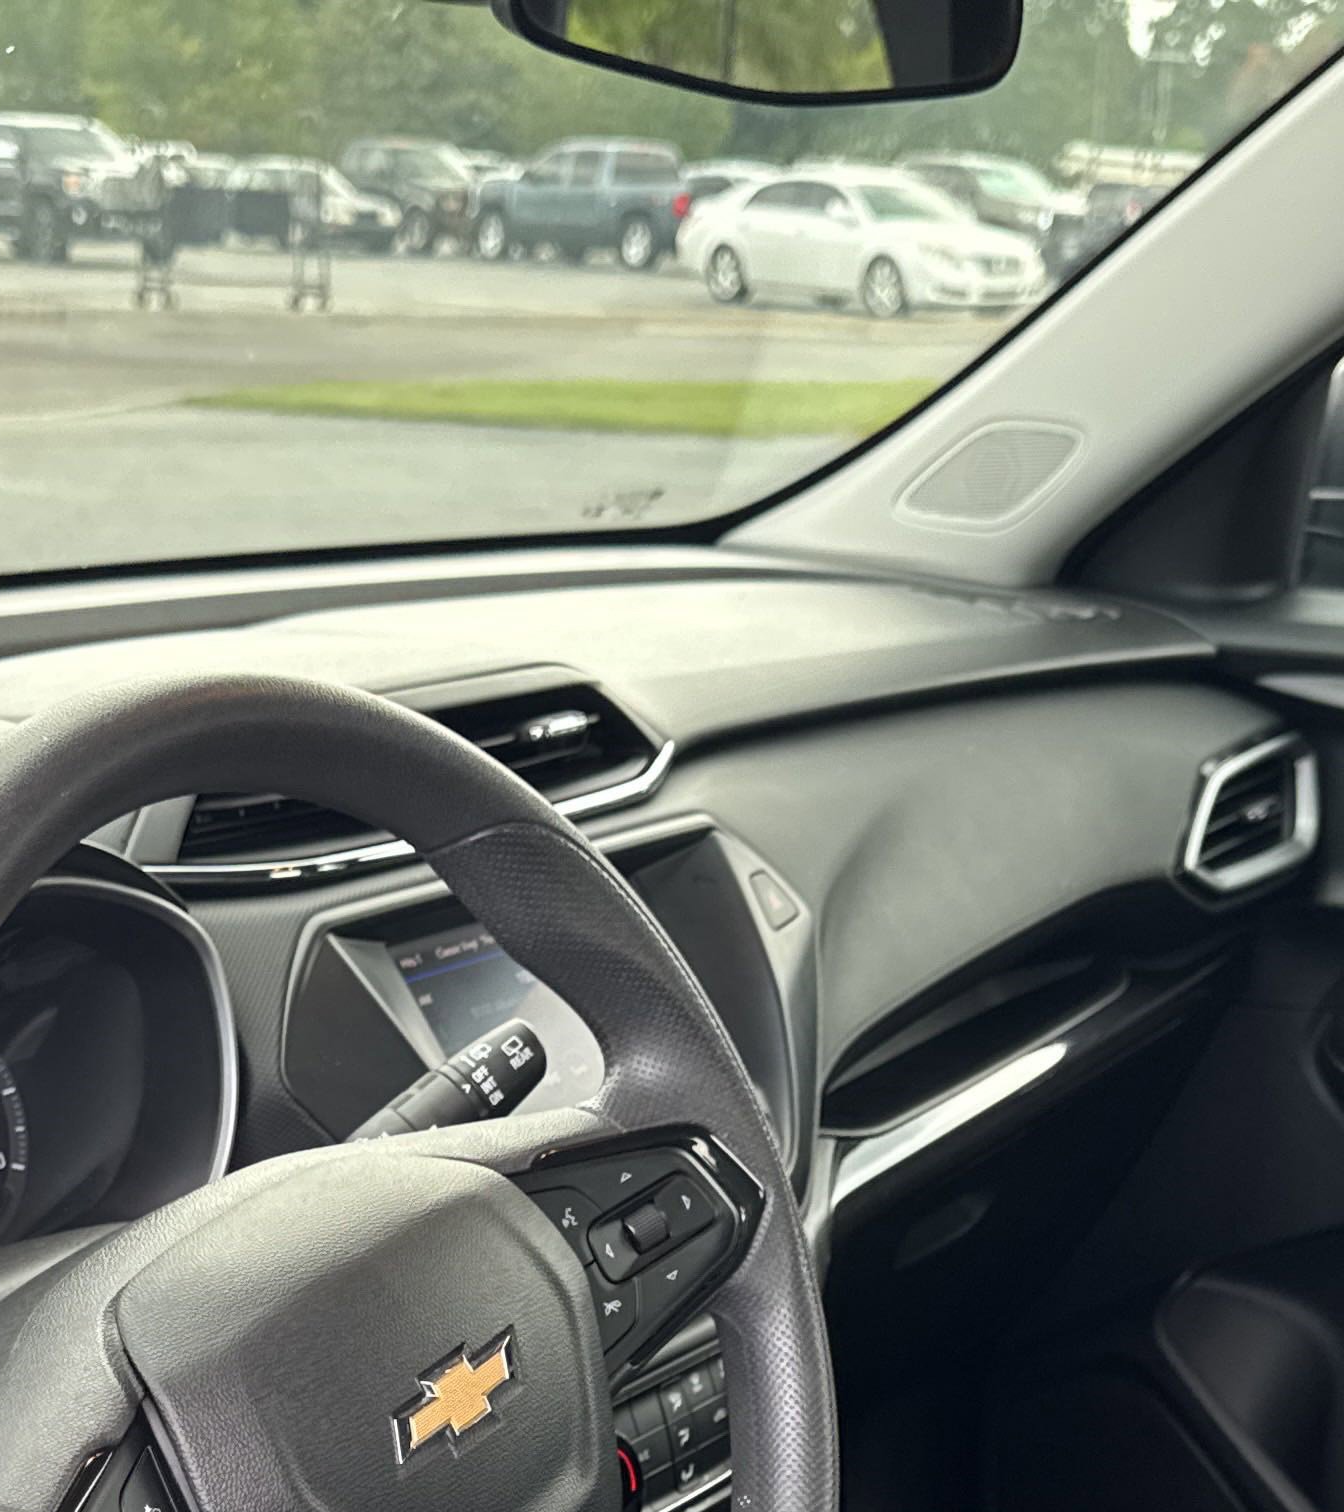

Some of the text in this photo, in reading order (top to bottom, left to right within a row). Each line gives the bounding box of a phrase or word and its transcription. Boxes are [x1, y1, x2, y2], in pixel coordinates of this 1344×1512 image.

[510, 1047, 534, 1070] REAR
[472, 1065, 489, 1083] OFF
[489, 1088, 504, 1106] ON
